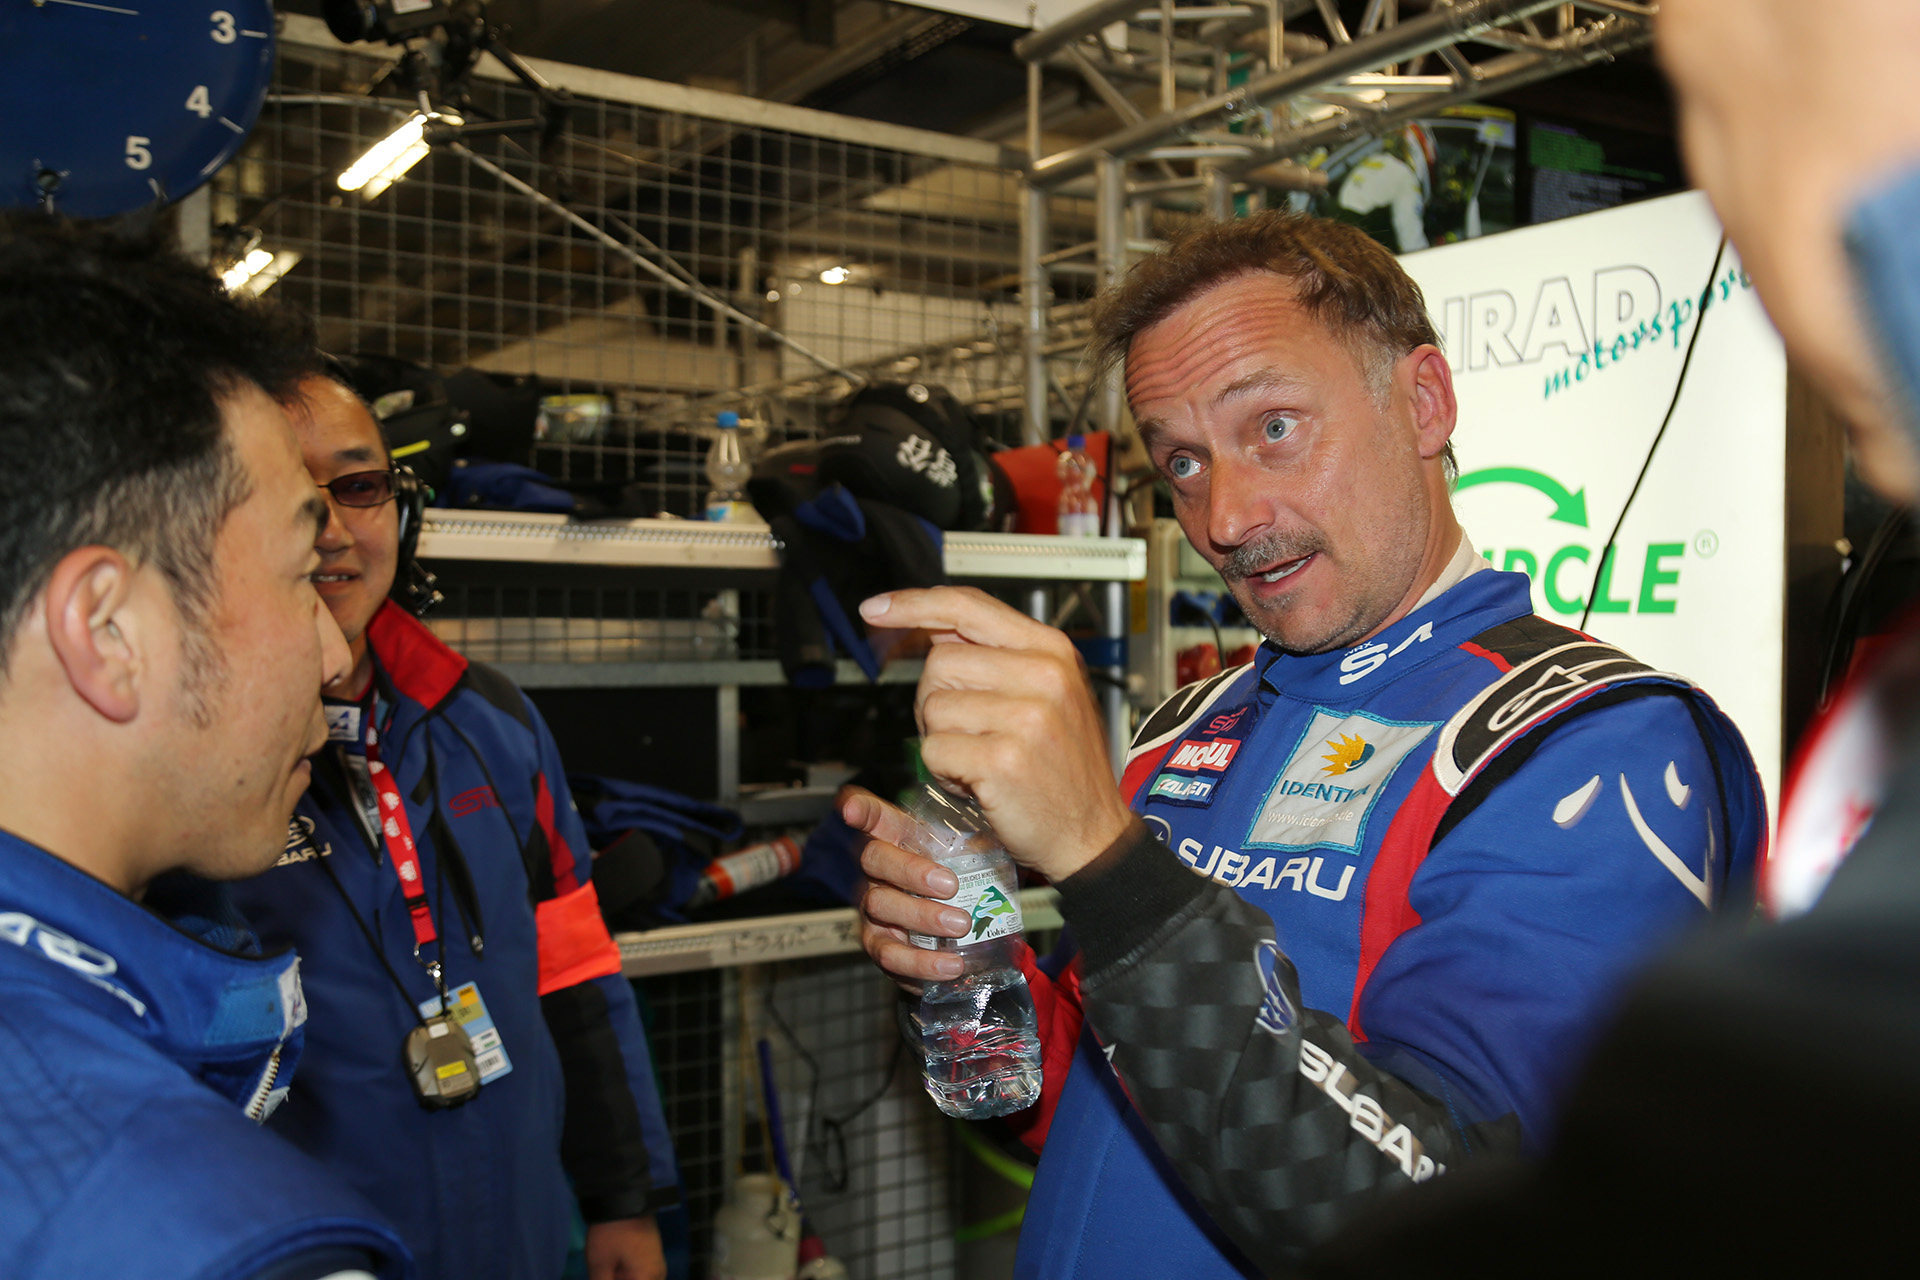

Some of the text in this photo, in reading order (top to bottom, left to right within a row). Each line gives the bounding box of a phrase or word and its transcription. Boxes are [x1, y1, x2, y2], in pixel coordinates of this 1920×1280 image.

[209, 10, 238, 45] 3
[184, 84, 214, 119] 4
[124, 134, 153, 171] 5
[1177, 837, 1357, 902] SUBARU
